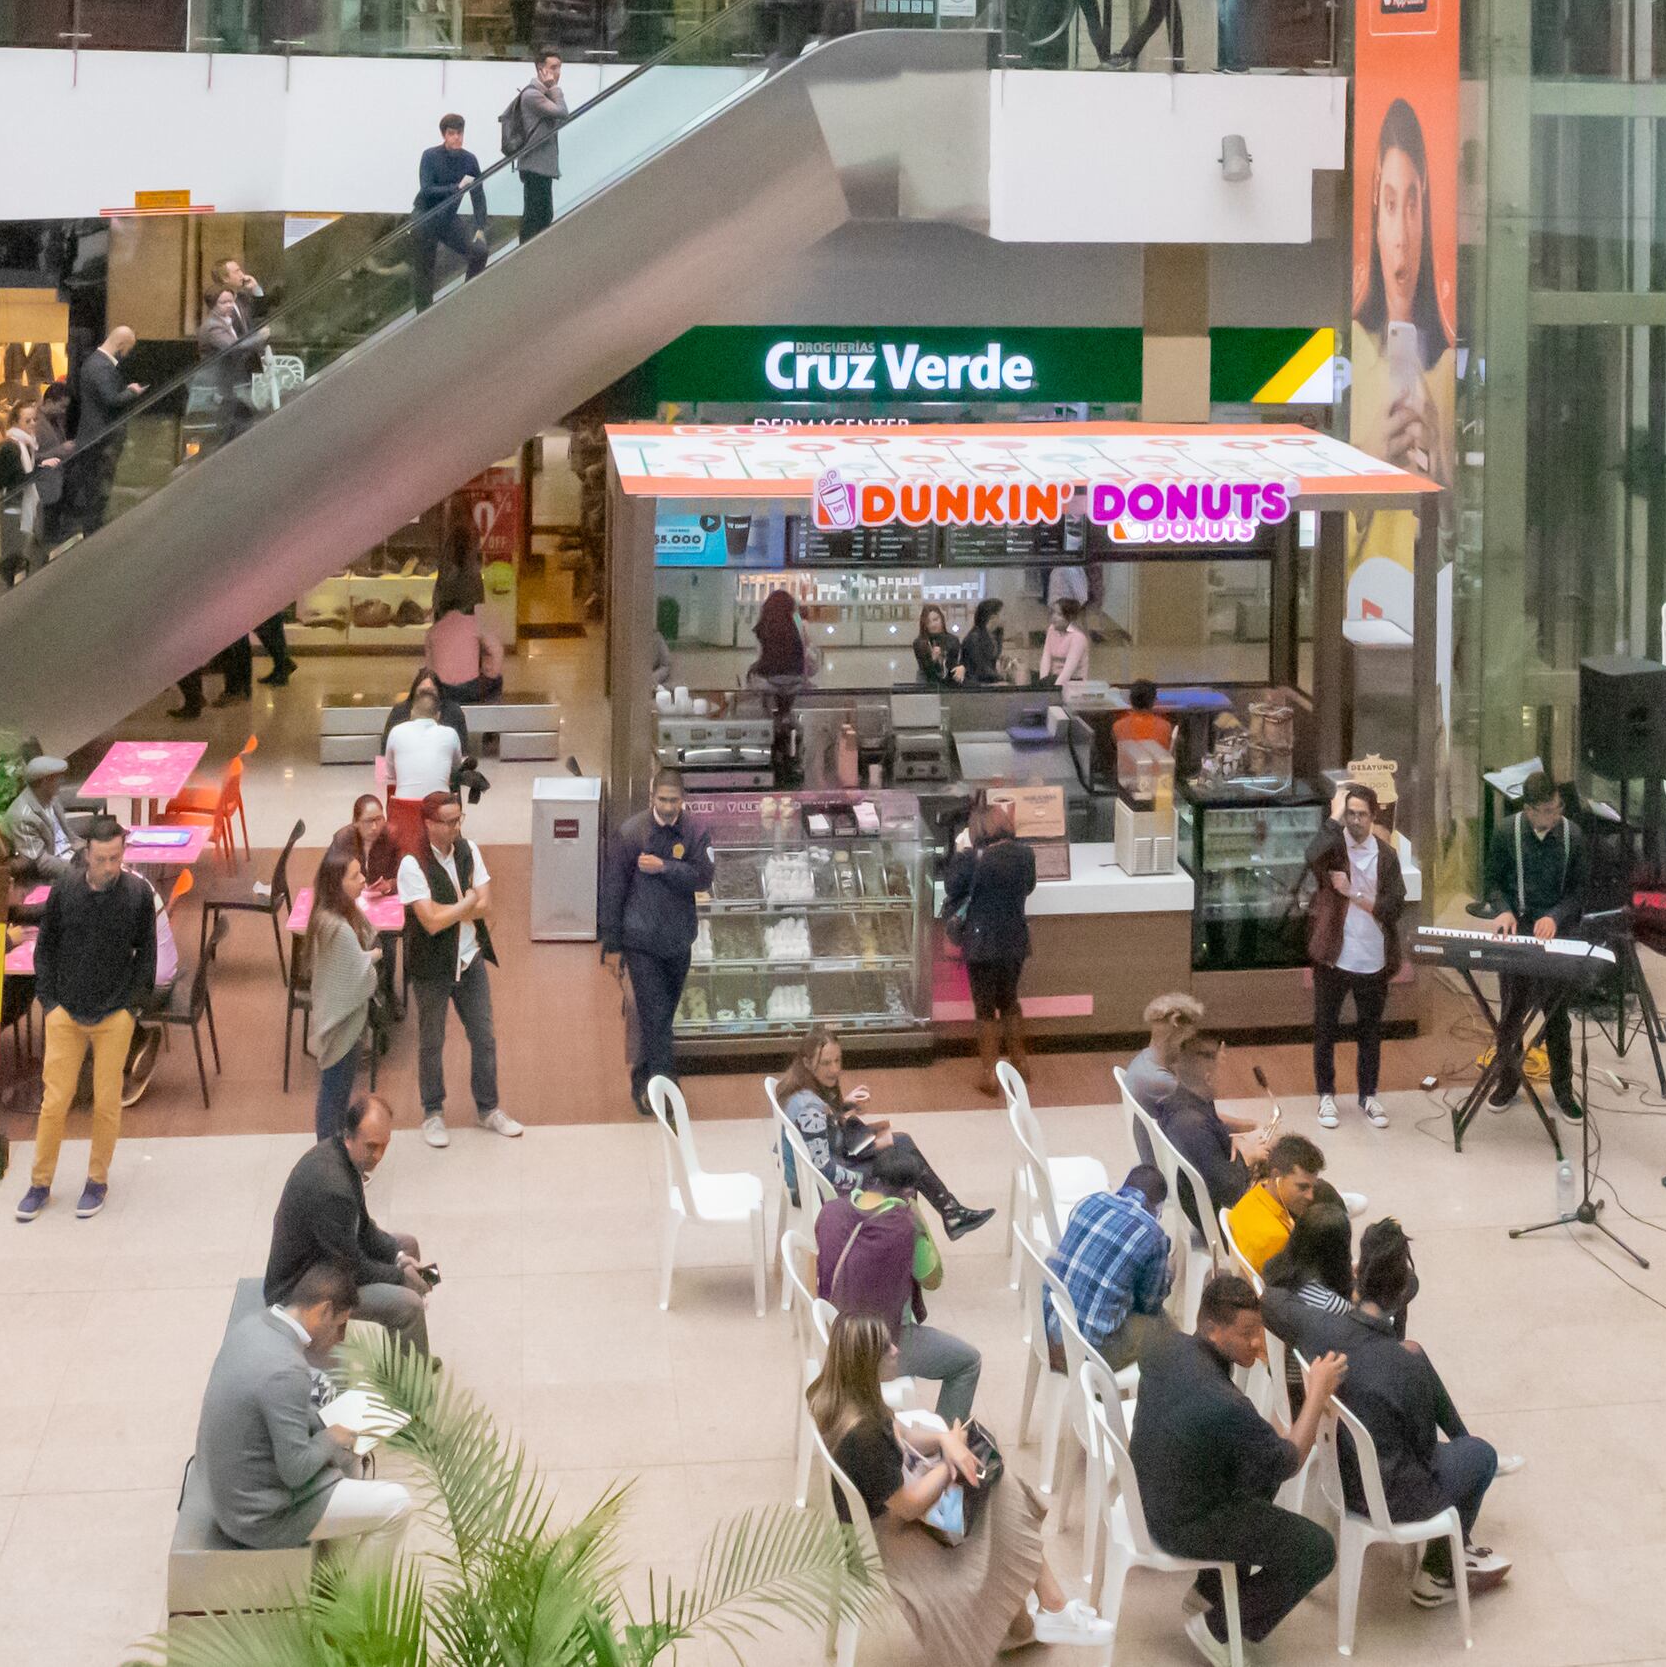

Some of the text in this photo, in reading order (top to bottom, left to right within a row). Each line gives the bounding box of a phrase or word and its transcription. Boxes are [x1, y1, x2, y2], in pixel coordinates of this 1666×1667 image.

[795, 340, 876, 354] DROGUERÍAS
[764, 340, 1034, 391] Cruz Verde
[861, 482, 1291, 524] DUNKIN' DONUTS
[1154, 518, 1253, 540] DONUTS
